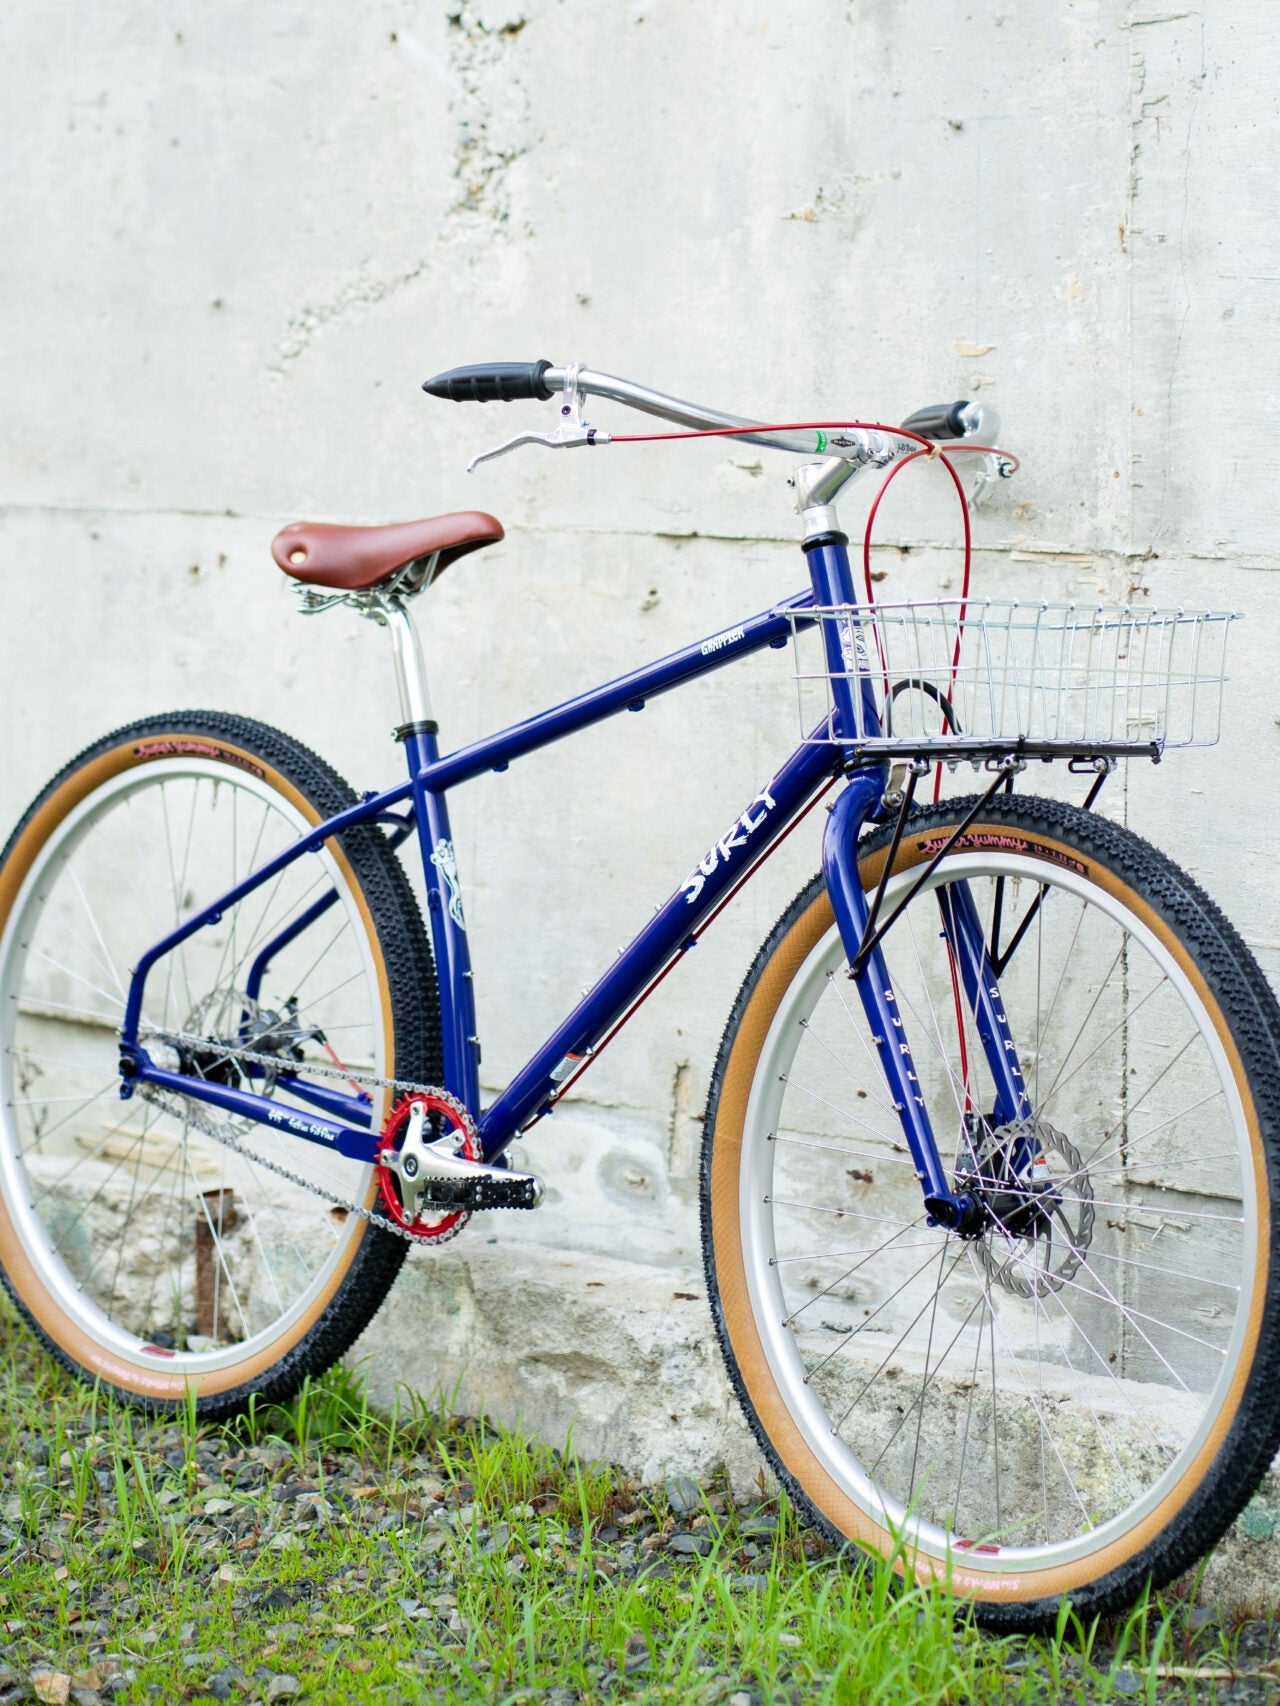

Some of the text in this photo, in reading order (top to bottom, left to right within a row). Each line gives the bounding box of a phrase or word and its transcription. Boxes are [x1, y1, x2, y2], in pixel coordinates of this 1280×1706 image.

[680, 779, 777, 904] SURLY
[884, 989, 925, 1107] SURLY
[989, 986, 1030, 1102] SURLY
